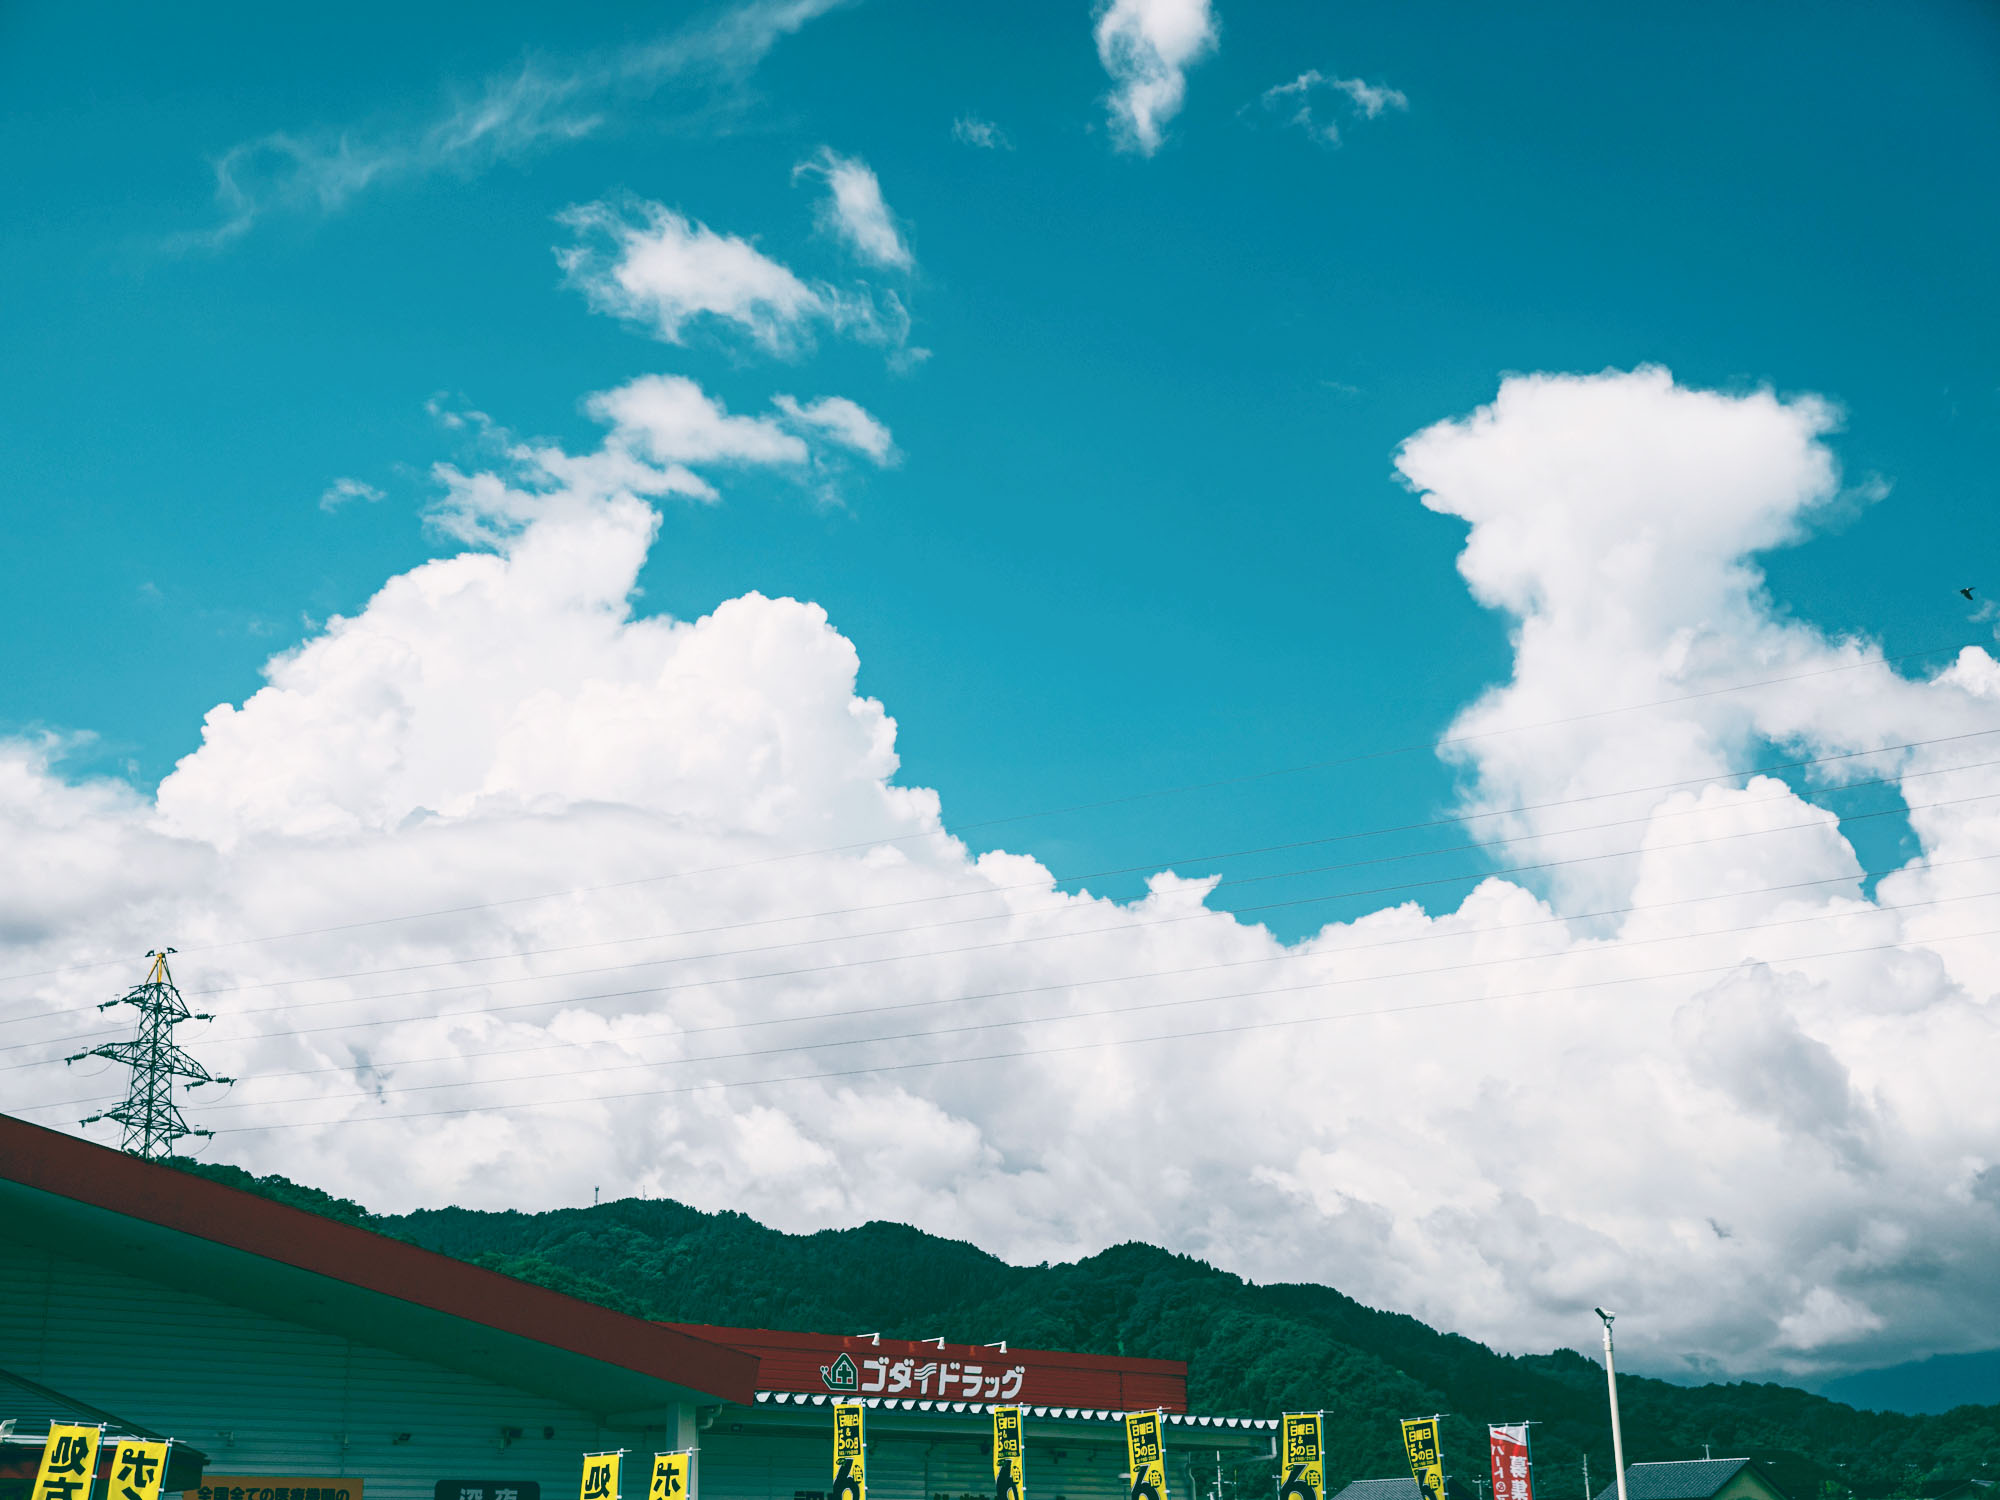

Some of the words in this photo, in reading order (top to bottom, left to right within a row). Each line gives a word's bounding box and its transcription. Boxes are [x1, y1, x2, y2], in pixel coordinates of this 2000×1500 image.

[862, 1356, 1025, 1399] ゴダイドラッグ
[1290, 1443, 1316, 1457] 5の日
